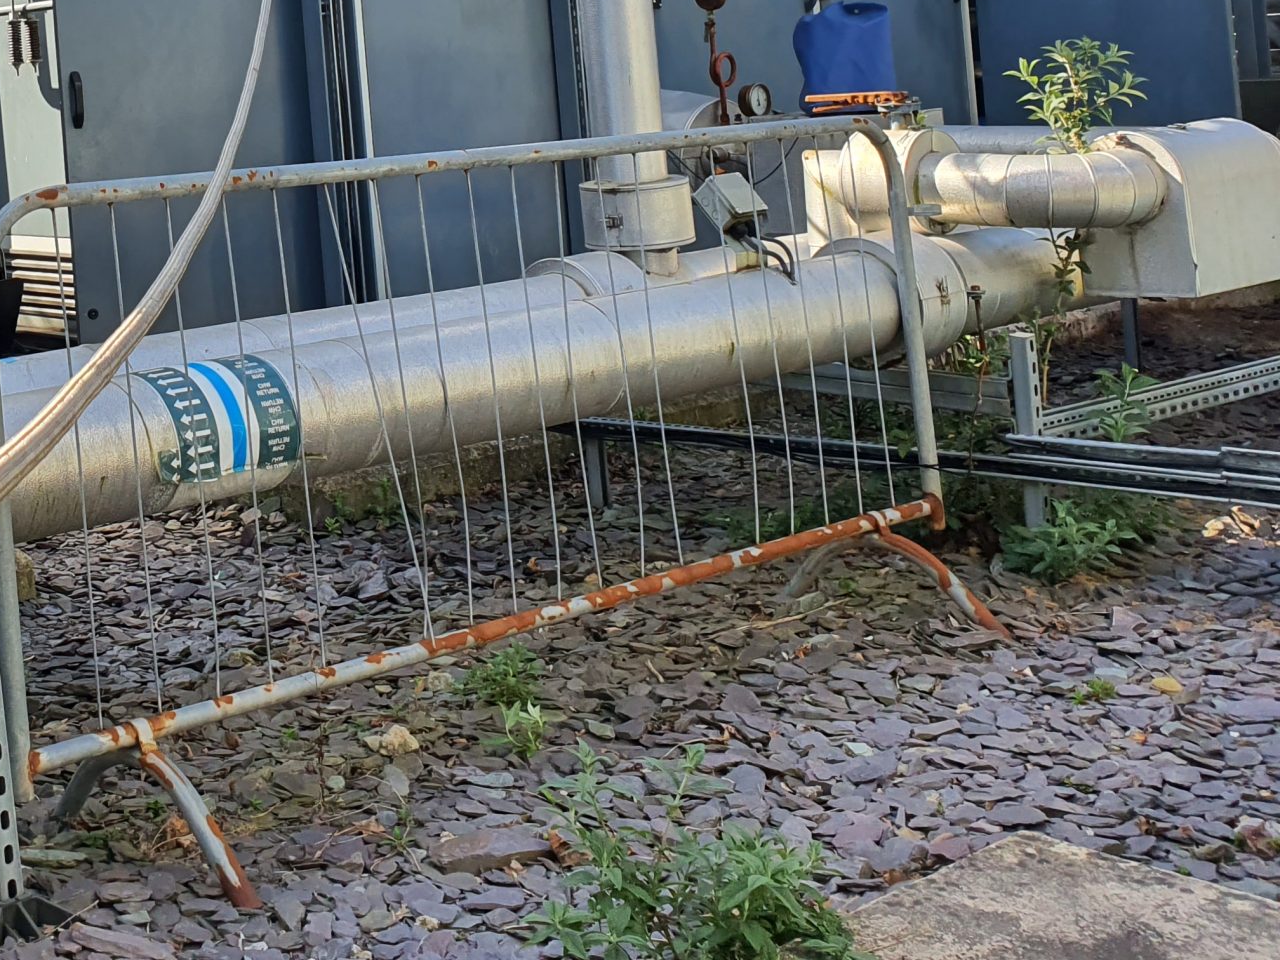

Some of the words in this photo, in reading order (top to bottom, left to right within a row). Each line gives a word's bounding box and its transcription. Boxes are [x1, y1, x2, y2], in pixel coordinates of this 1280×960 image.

[256, 388, 280, 396] RETURN
[261, 398, 284, 407] RETURN
[268, 425, 290, 434] RETURN
[269, 437, 290, 446] RETURN
